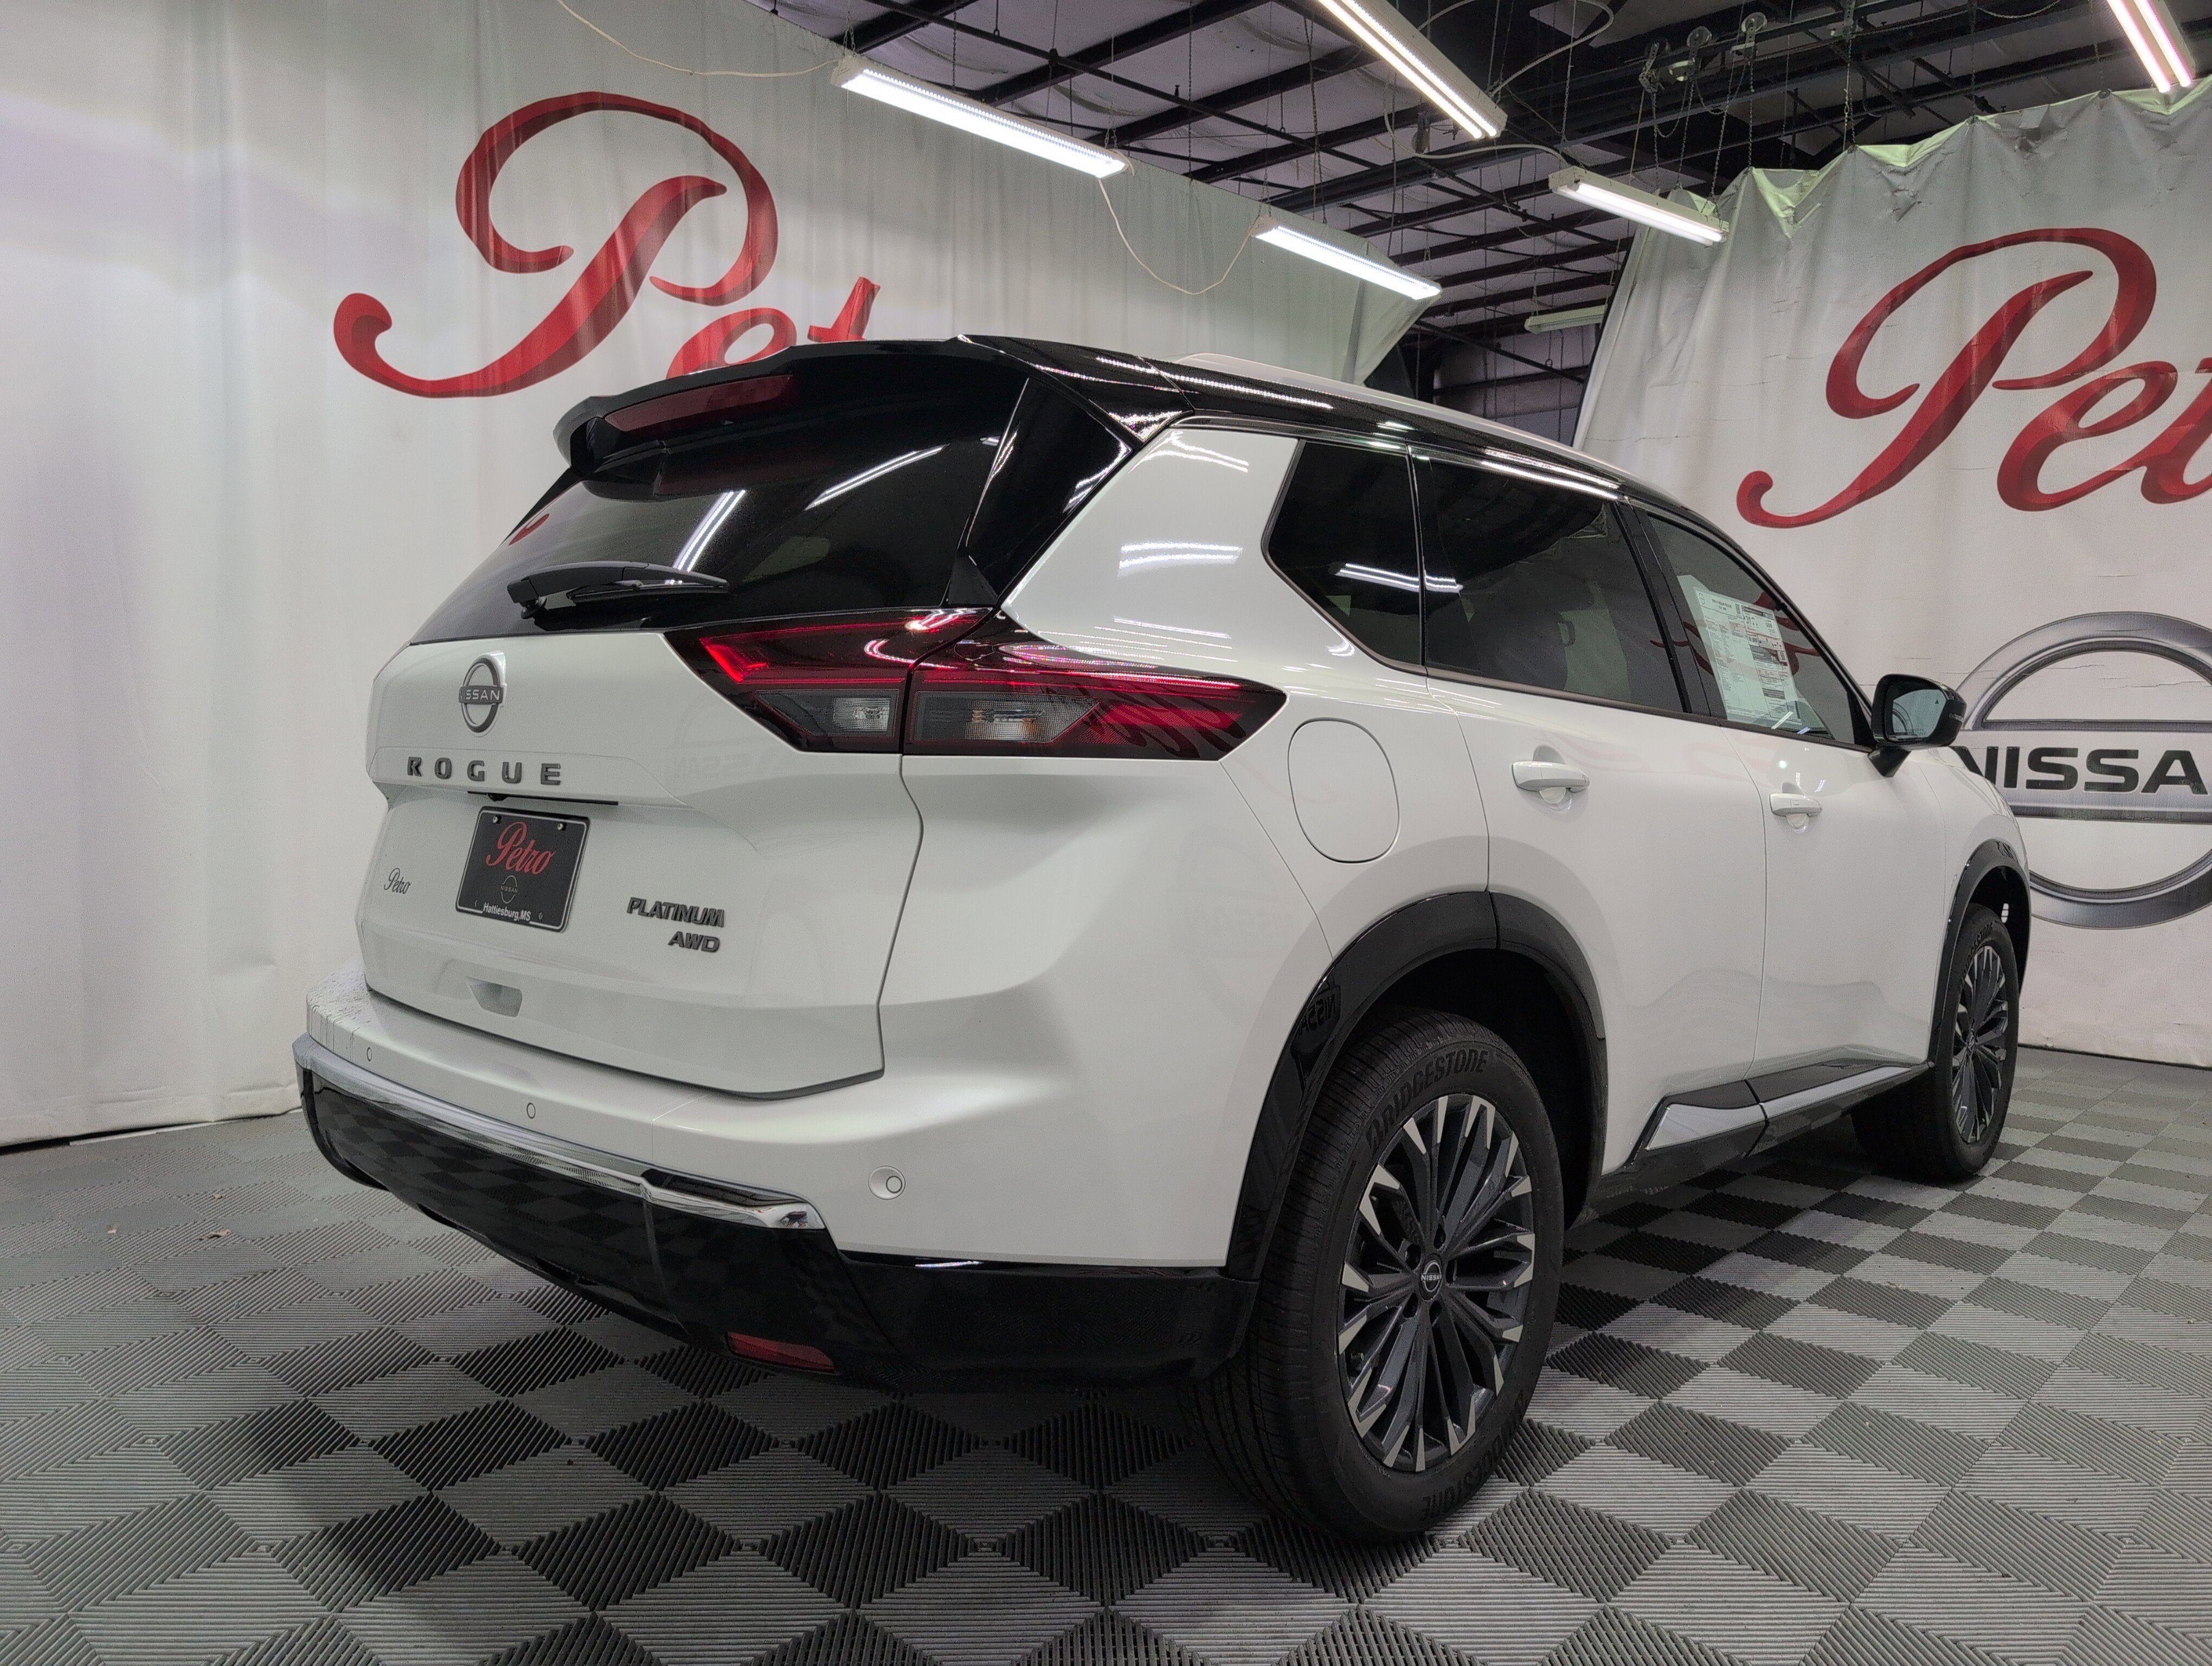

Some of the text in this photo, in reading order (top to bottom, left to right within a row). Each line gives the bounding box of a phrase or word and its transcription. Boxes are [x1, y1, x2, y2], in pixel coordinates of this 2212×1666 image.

[461, 689, 501, 701] SSAN
[407, 757, 561, 786] ROGUE
[486, 821, 556, 875] Petro
[384, 868, 412, 895] Petro
[627, 896, 725, 928] PLATINUM
[667, 931, 720, 953] AWD
[1366, 1049, 1489, 1158] BRIDGESTONE
